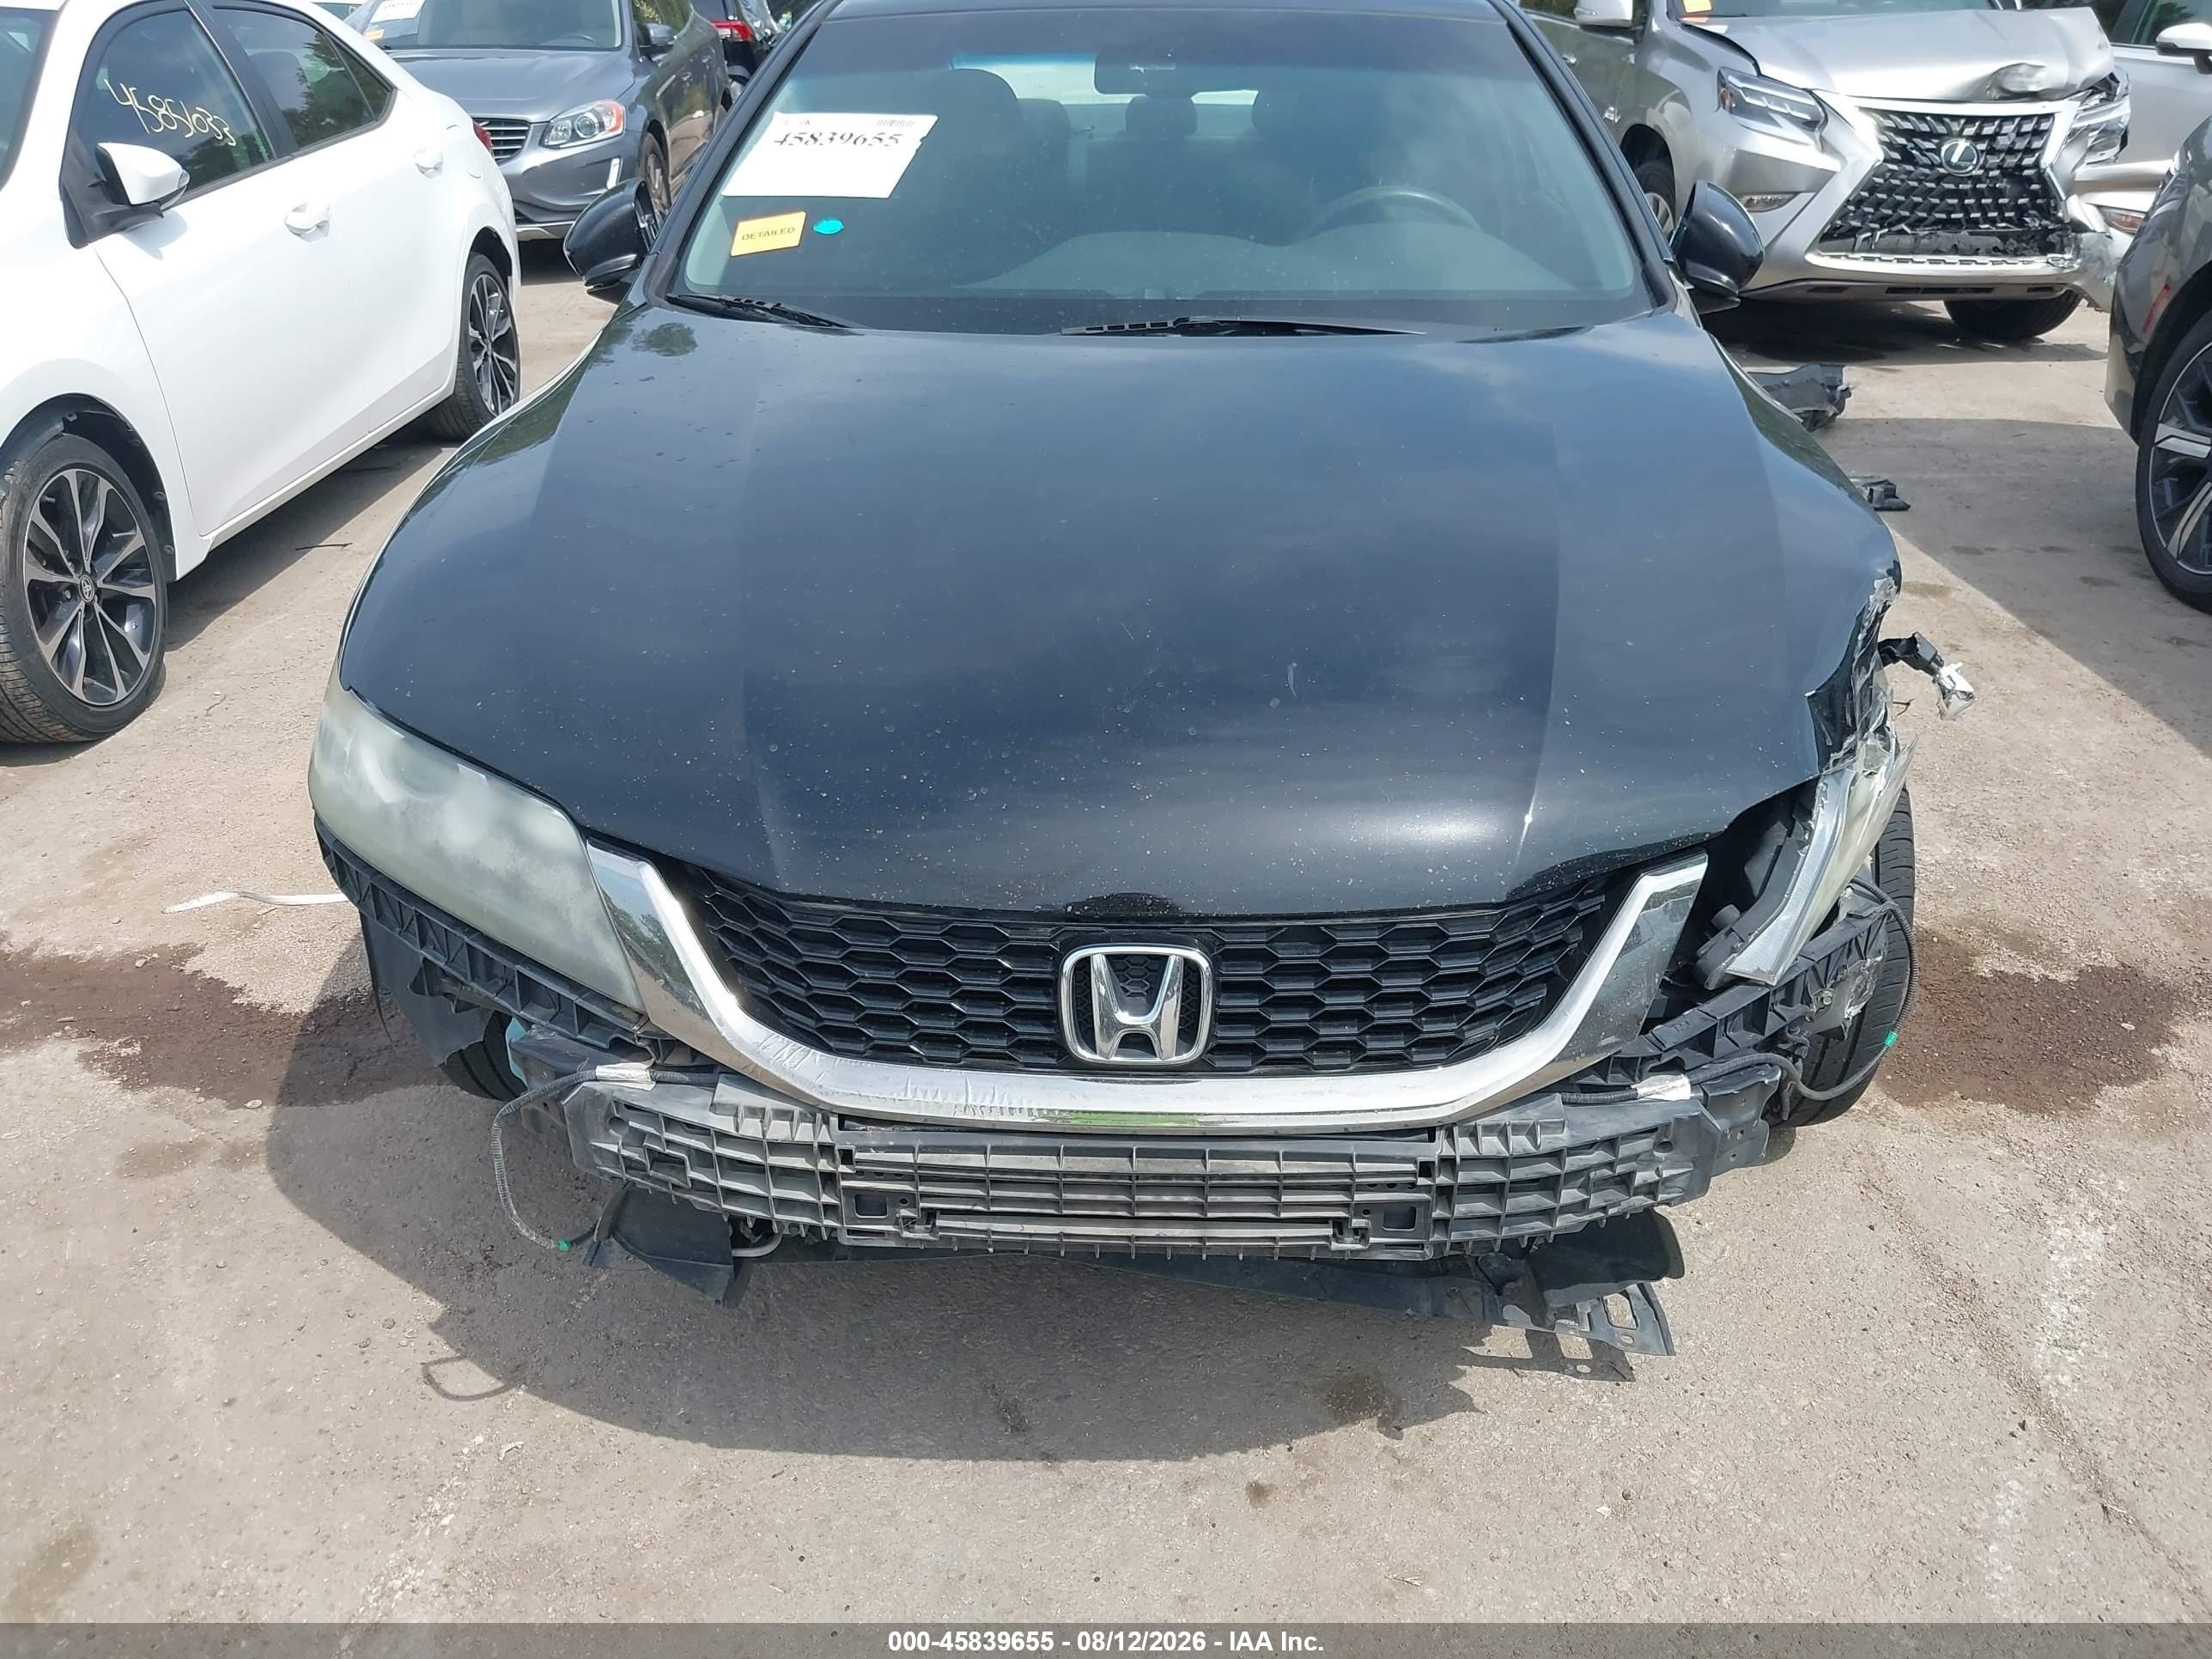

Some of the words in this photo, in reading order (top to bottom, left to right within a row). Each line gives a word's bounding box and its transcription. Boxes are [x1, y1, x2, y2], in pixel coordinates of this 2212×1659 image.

[103, 78, 236, 146] 45851033
[774, 131, 903, 147] 45839655
[741, 227, 796, 241] DETAILED
